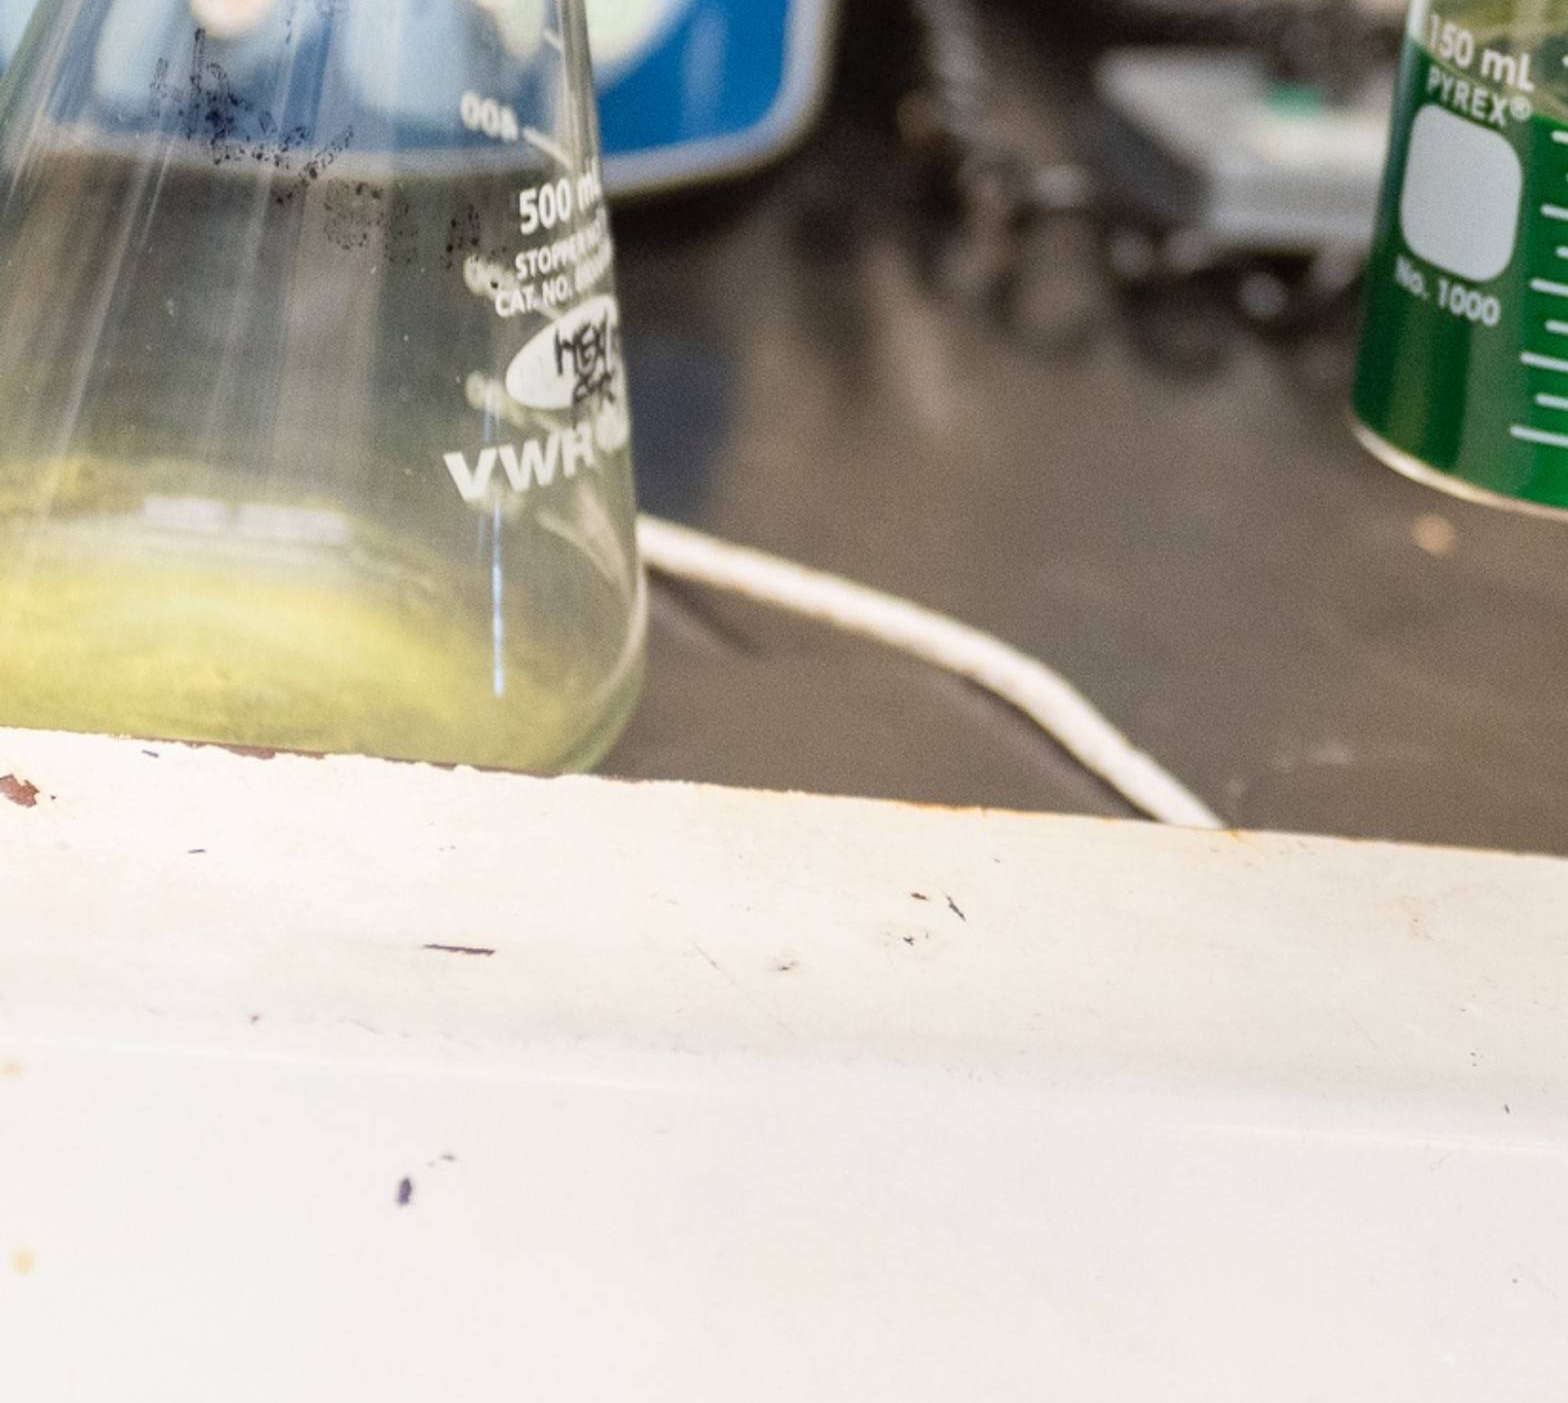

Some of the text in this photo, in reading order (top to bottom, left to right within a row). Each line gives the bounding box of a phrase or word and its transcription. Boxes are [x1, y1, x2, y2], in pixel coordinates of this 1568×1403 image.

[1428, 13, 1534, 92] 150 mL
[519, 178, 571, 235] 500
[1395, 255, 1500, 326] No. 1000
[443, 422, 596, 502] VWR
